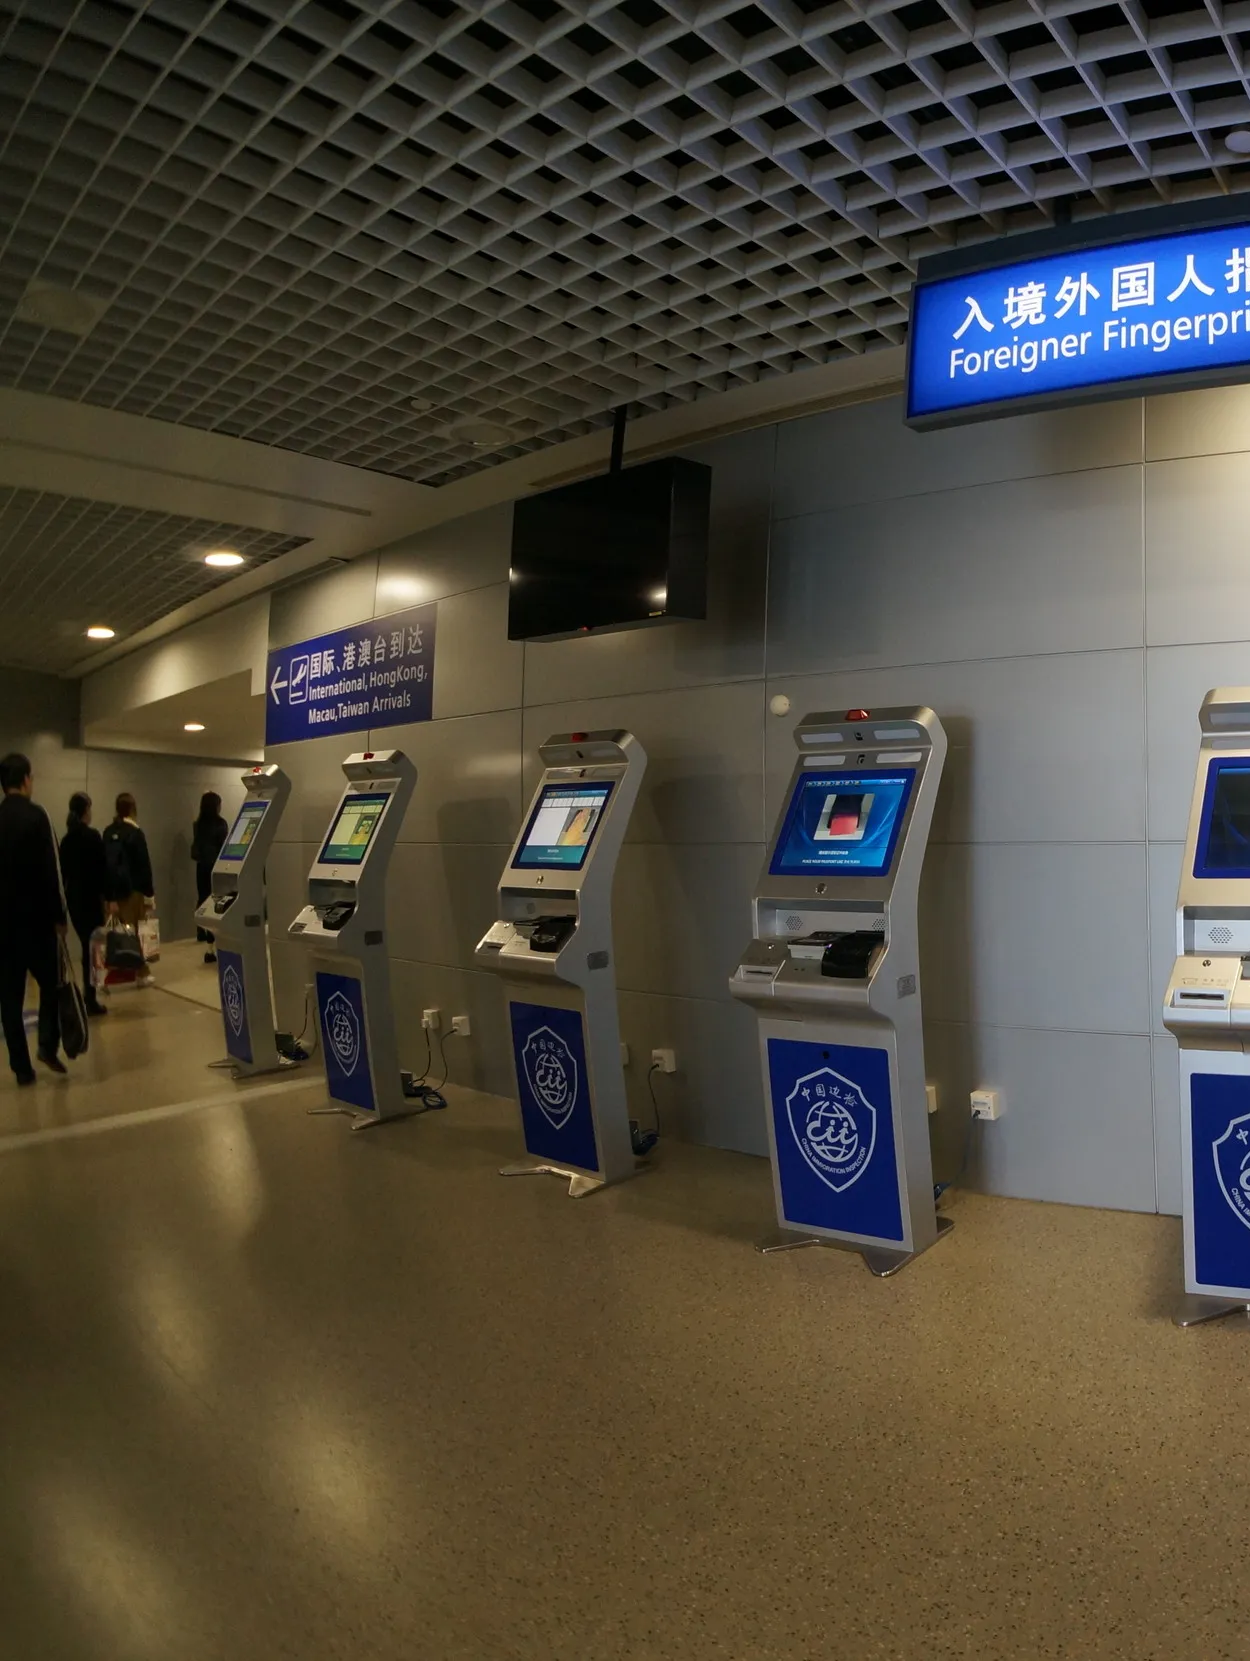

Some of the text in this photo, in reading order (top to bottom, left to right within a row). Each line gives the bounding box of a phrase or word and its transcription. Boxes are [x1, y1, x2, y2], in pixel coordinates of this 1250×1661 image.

[950, 311, 1093, 380] Foreigner
[310, 624, 423, 680] 国际、港澳台到达
[308, 664, 428, 702] International, HongKong,
[372, 690, 411, 713] Arrivals
[1231, 1187, 1245, 1209] CHINA
